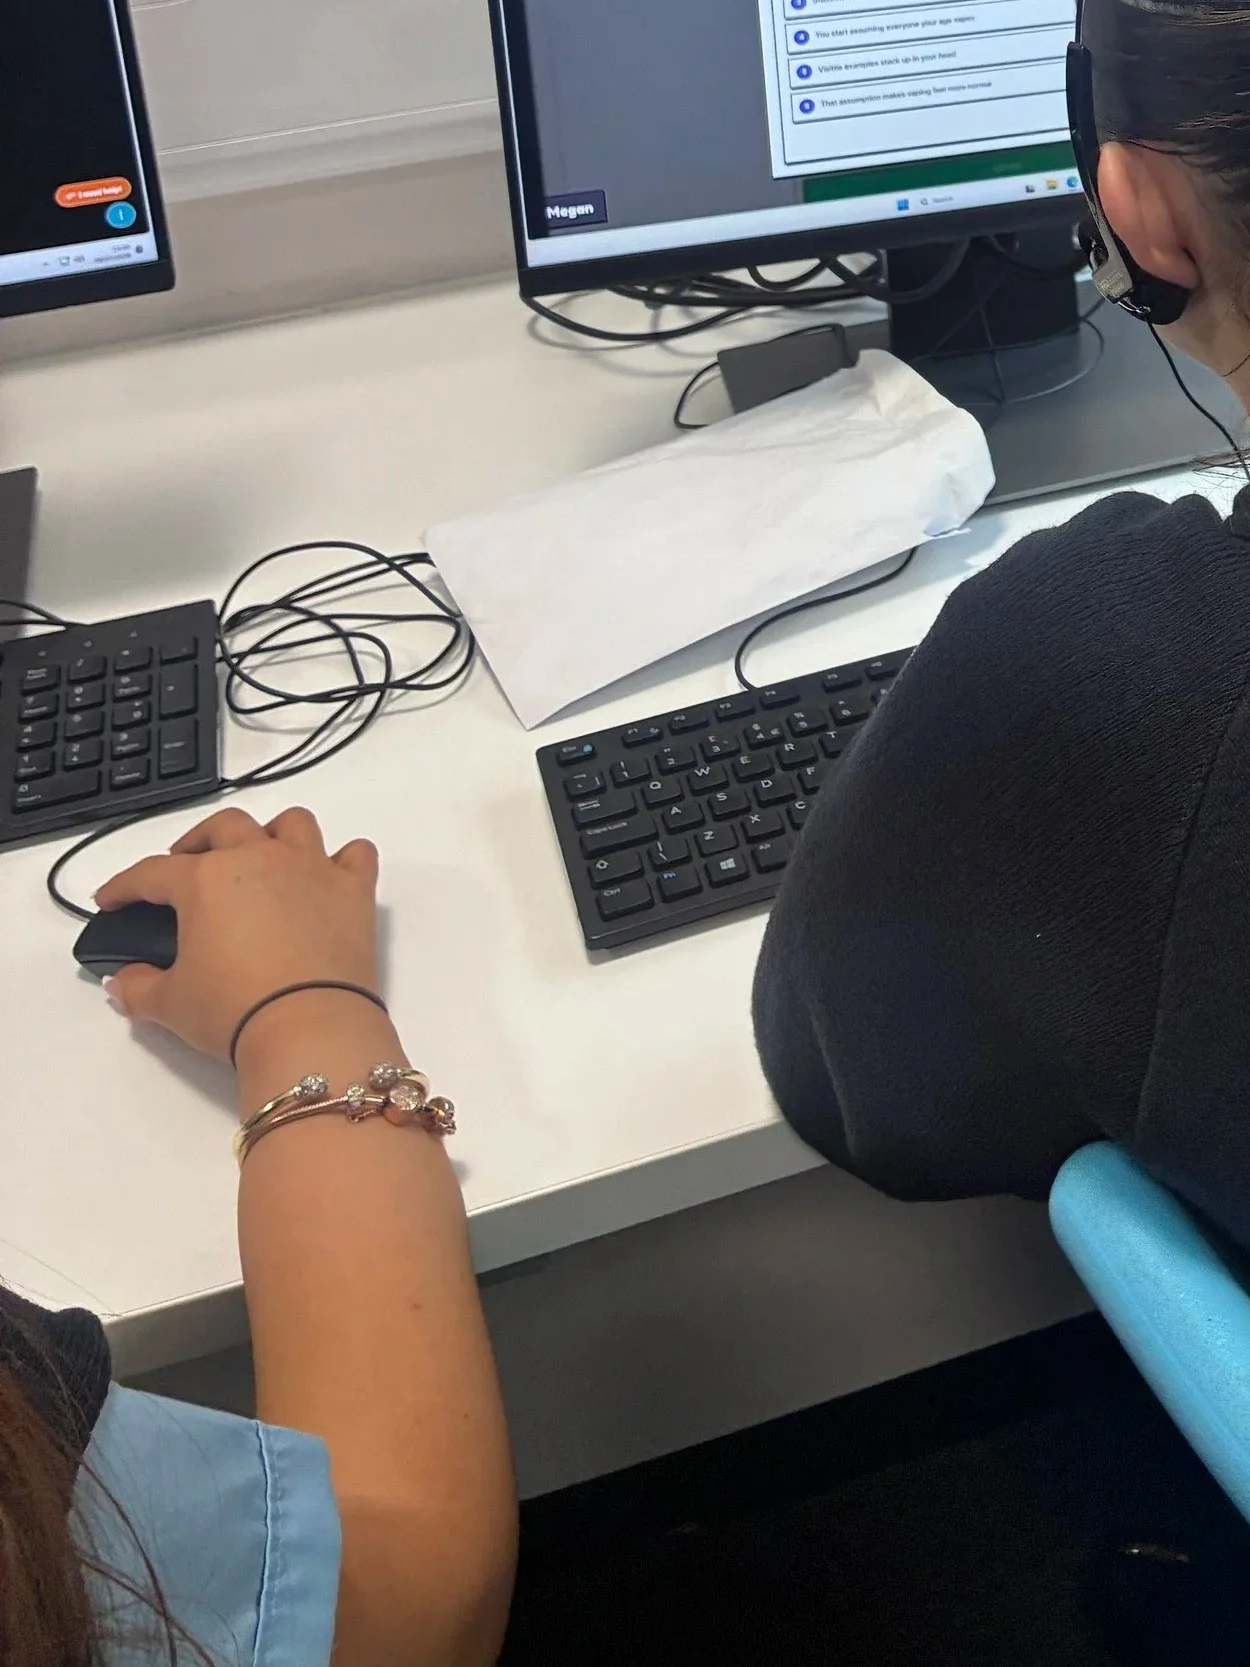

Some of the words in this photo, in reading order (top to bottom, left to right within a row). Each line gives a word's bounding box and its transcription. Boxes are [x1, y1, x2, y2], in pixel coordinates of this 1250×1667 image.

[815, 29, 830, 40] You
[830, 27, 848, 38] start
[849, 24, 885, 37] assuming
[885, 21, 920, 34] everyone
[920, 19, 938, 30] your
[938, 17, 953, 29] age
[953, 15, 976, 27] vapes
[817, 63, 843, 74] Visible
[843, 59, 880, 73] examples
[880, 56, 901, 67] stack
[901, 55, 913, 67] up
[920, 52, 938, 64] your
[937, 49, 957, 61] head
[820, 98, 839, 108] That
[839, 93, 882, 107] assumption
[882, 90, 907, 101] makes
[906, 87, 933, 100] vaping
[546, 203, 595, 220] Megan
[825, 730, 838, 739] T
[784, 742, 796, 752] R
[739, 755, 751, 765] E
[694, 765, 712, 777] W
[806, 765, 817, 776] F
[649, 781, 662, 791] Q
[760, 779, 774, 789] D
[716, 792, 728, 802] S
[670, 805, 683, 815] A
[794, 800, 807, 810] C
[749, 814, 762, 824] X
[586, 826, 608, 836] Caps
[703, 830, 715, 841] Z
[603, 887, 622, 898] Ctrl
